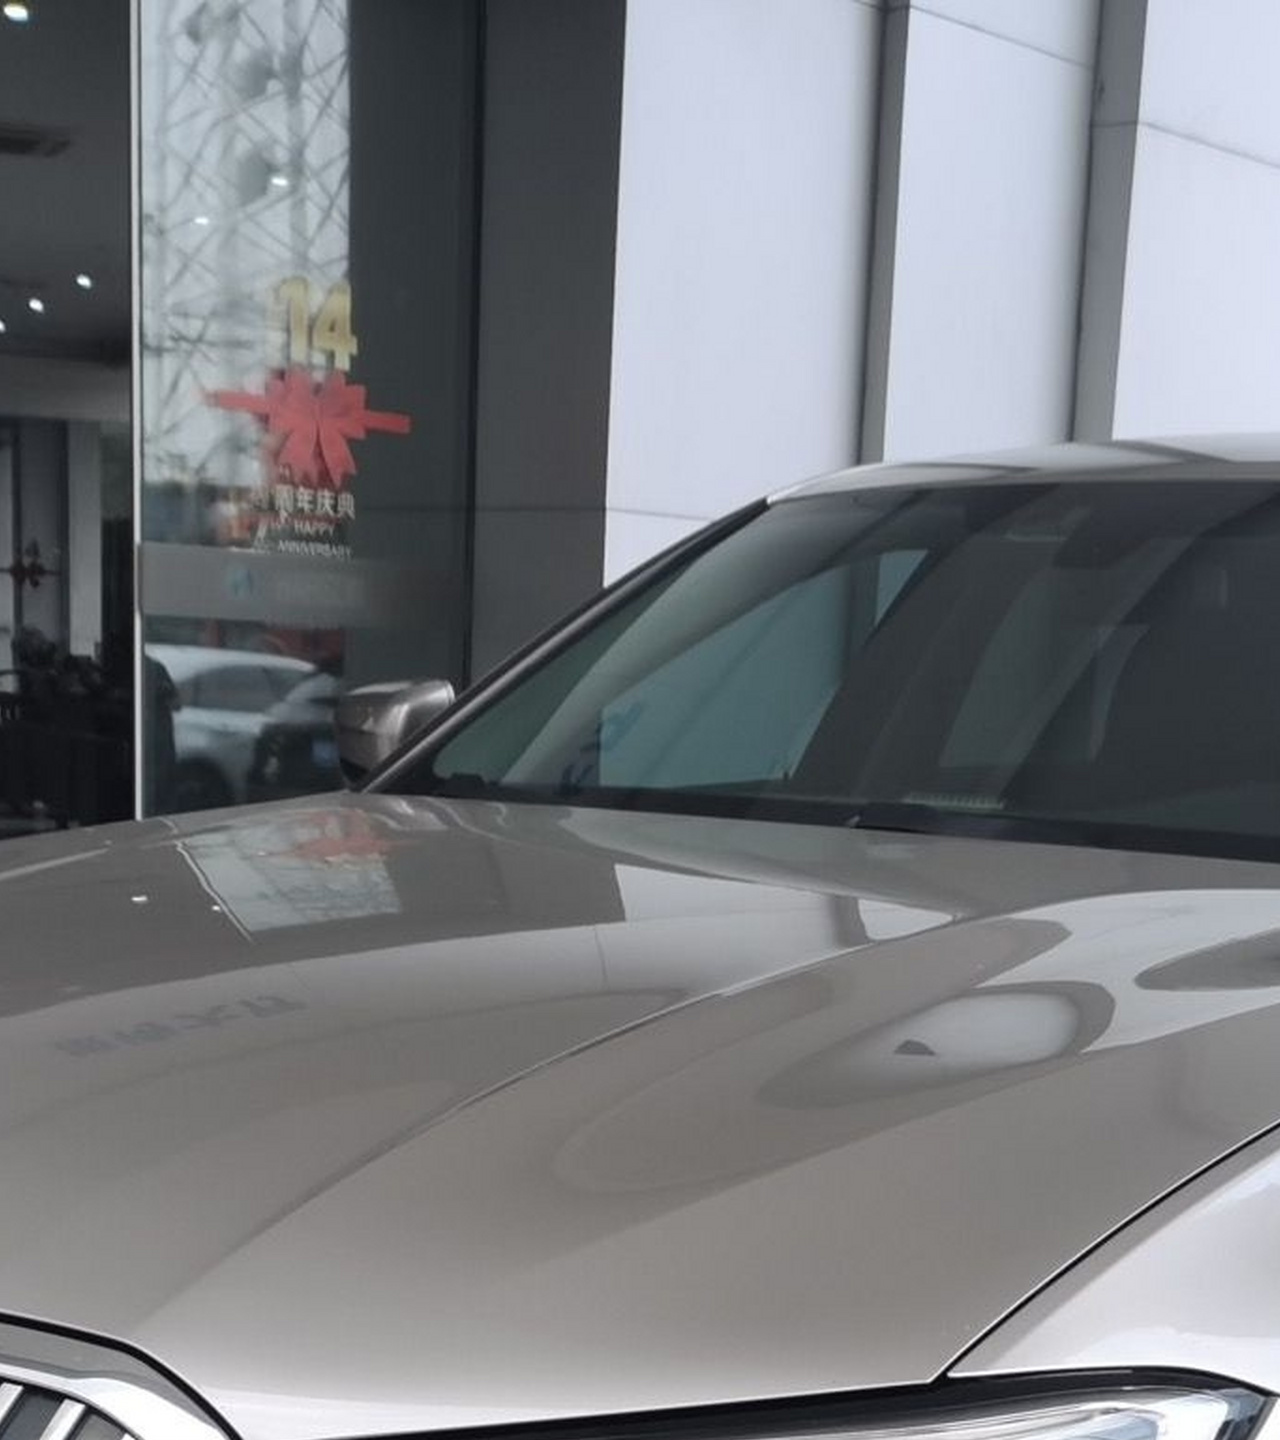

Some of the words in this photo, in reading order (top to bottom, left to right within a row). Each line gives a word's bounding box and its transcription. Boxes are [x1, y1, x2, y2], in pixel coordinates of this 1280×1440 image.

[279, 276, 358, 371] 14
[275, 484, 355, 520] 周年庆典
